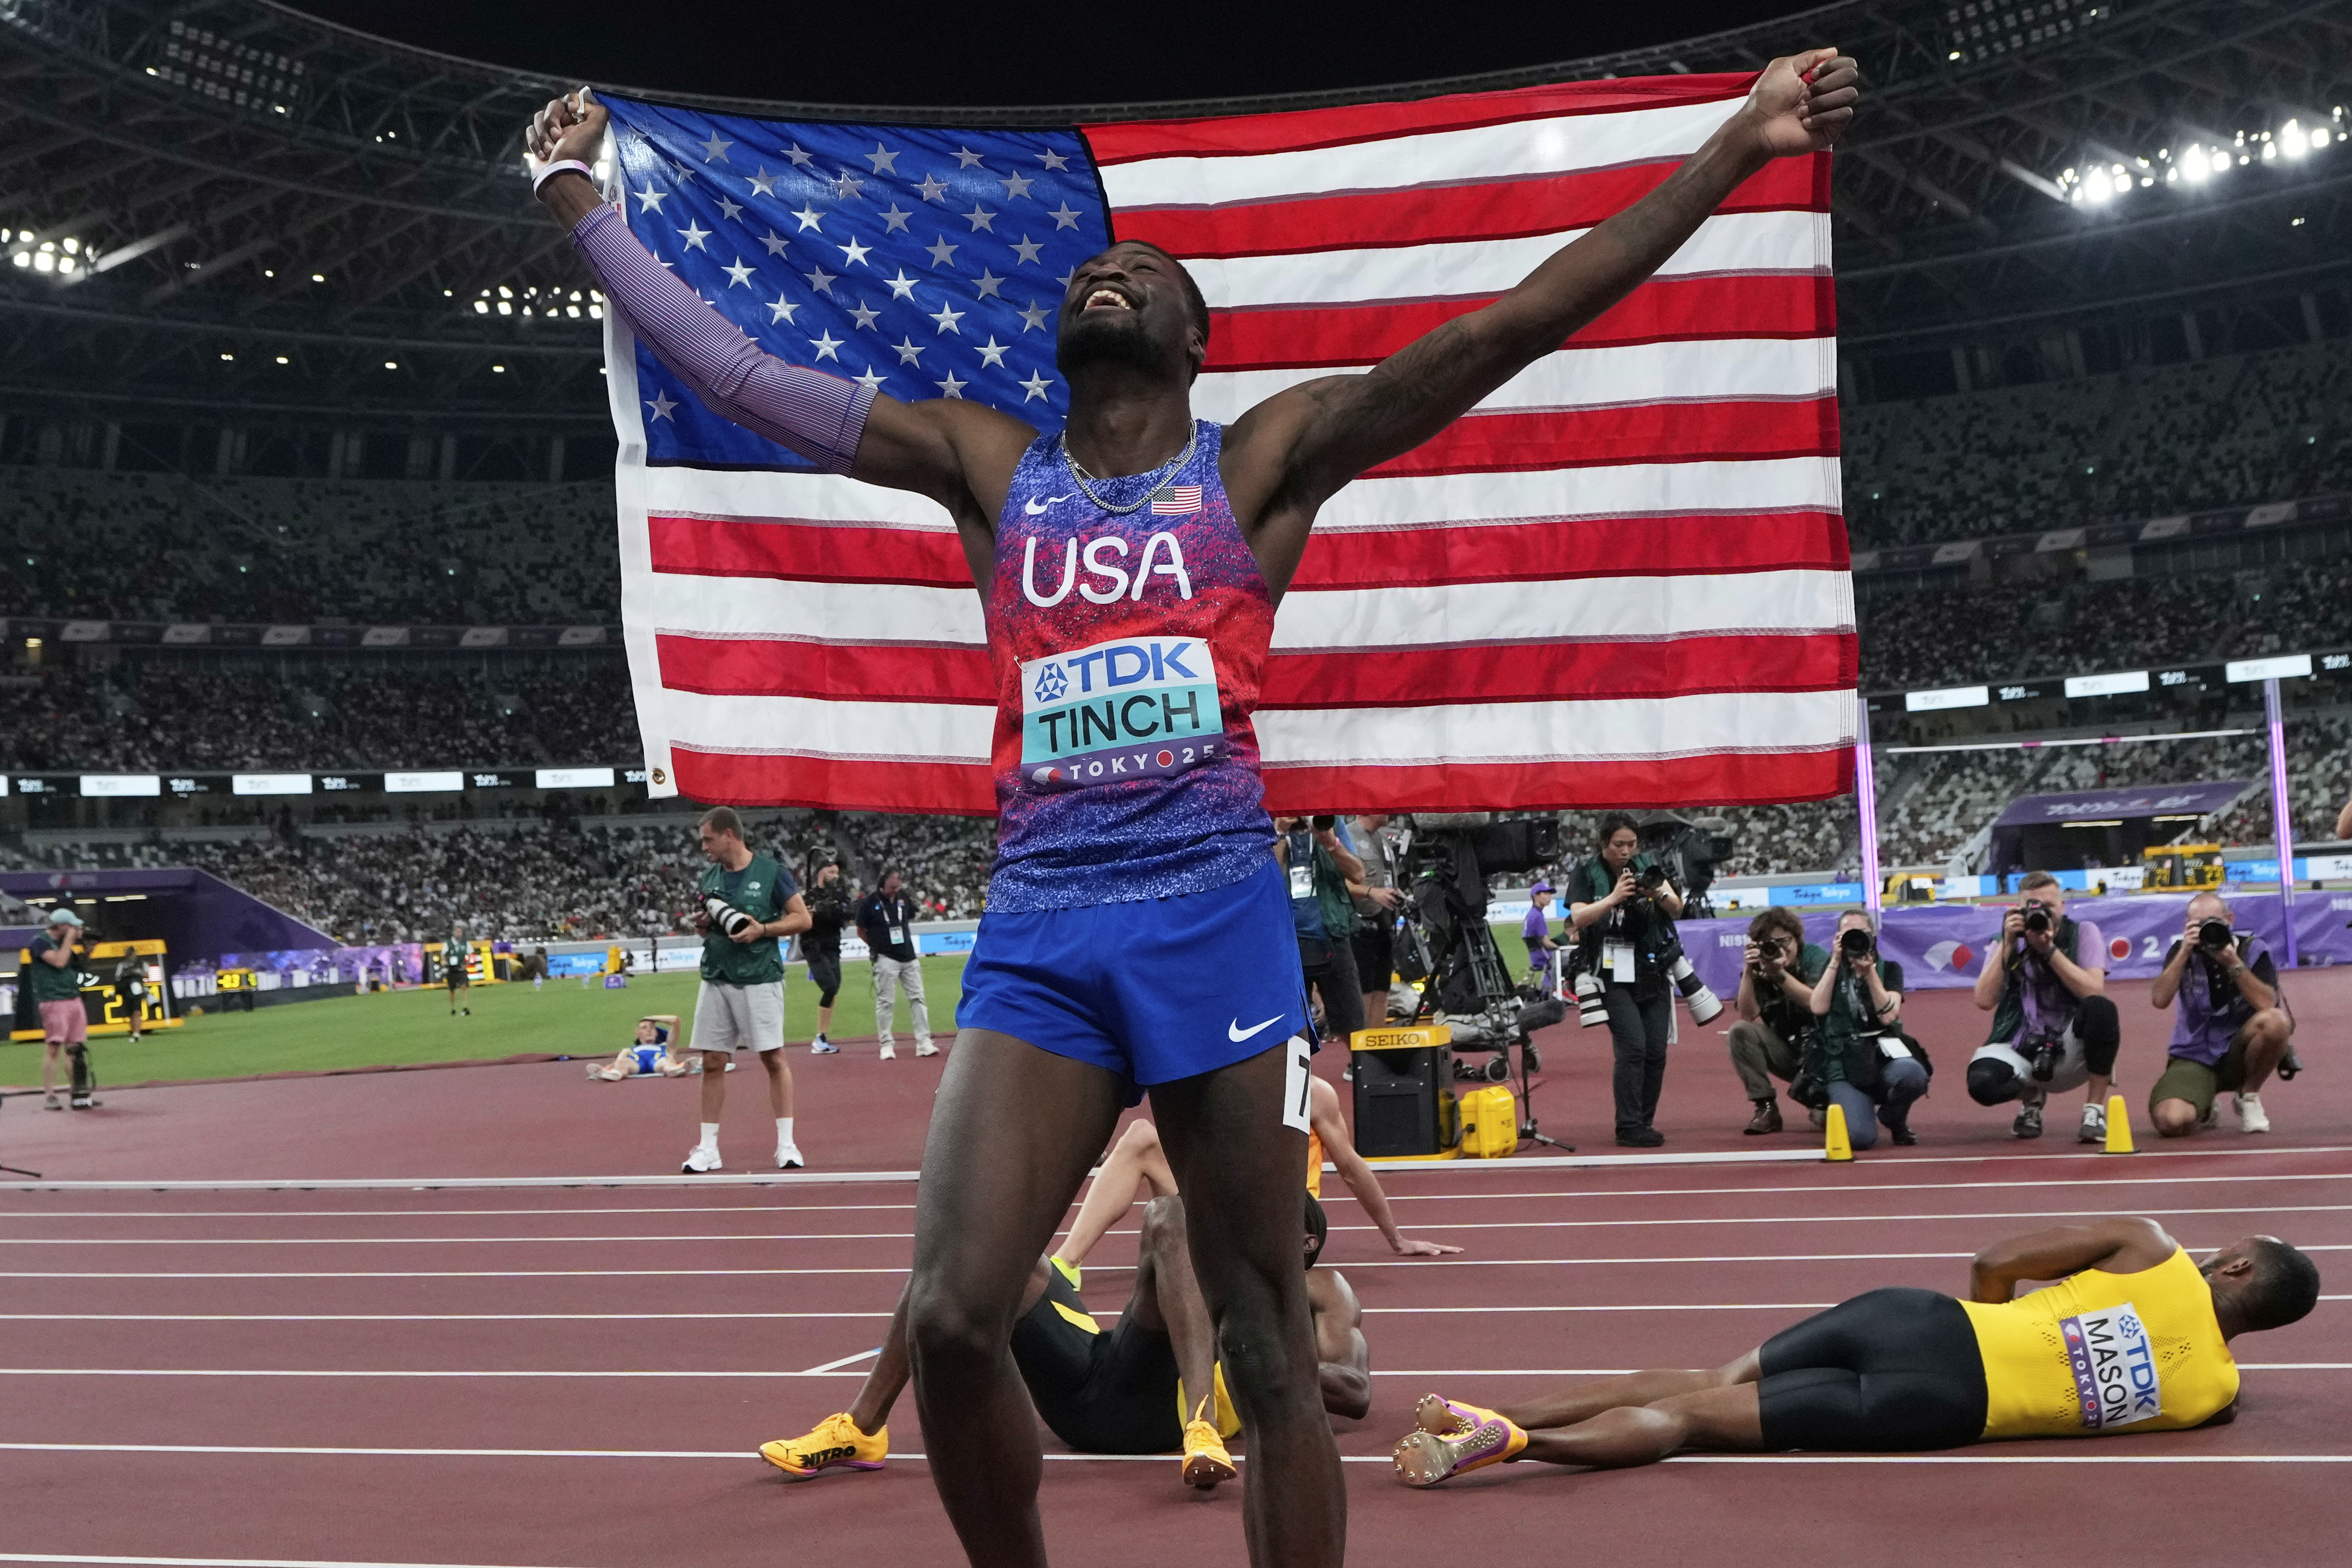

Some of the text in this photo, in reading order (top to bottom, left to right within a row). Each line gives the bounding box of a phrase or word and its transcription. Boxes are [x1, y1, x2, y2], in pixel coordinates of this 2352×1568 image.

[1022, 531, 1192, 607] USA
[1067, 642, 1199, 693] TDK
[1039, 691, 1200, 753] TINCH
[1793, 889, 1821, 903] Tokyo
[1366, 1034, 1419, 1047] SEIKO
[2085, 1317, 2128, 1423] MASON
[2126, 1335, 2156, 1413] TDK
[794, 1446, 856, 1468] NITRO
